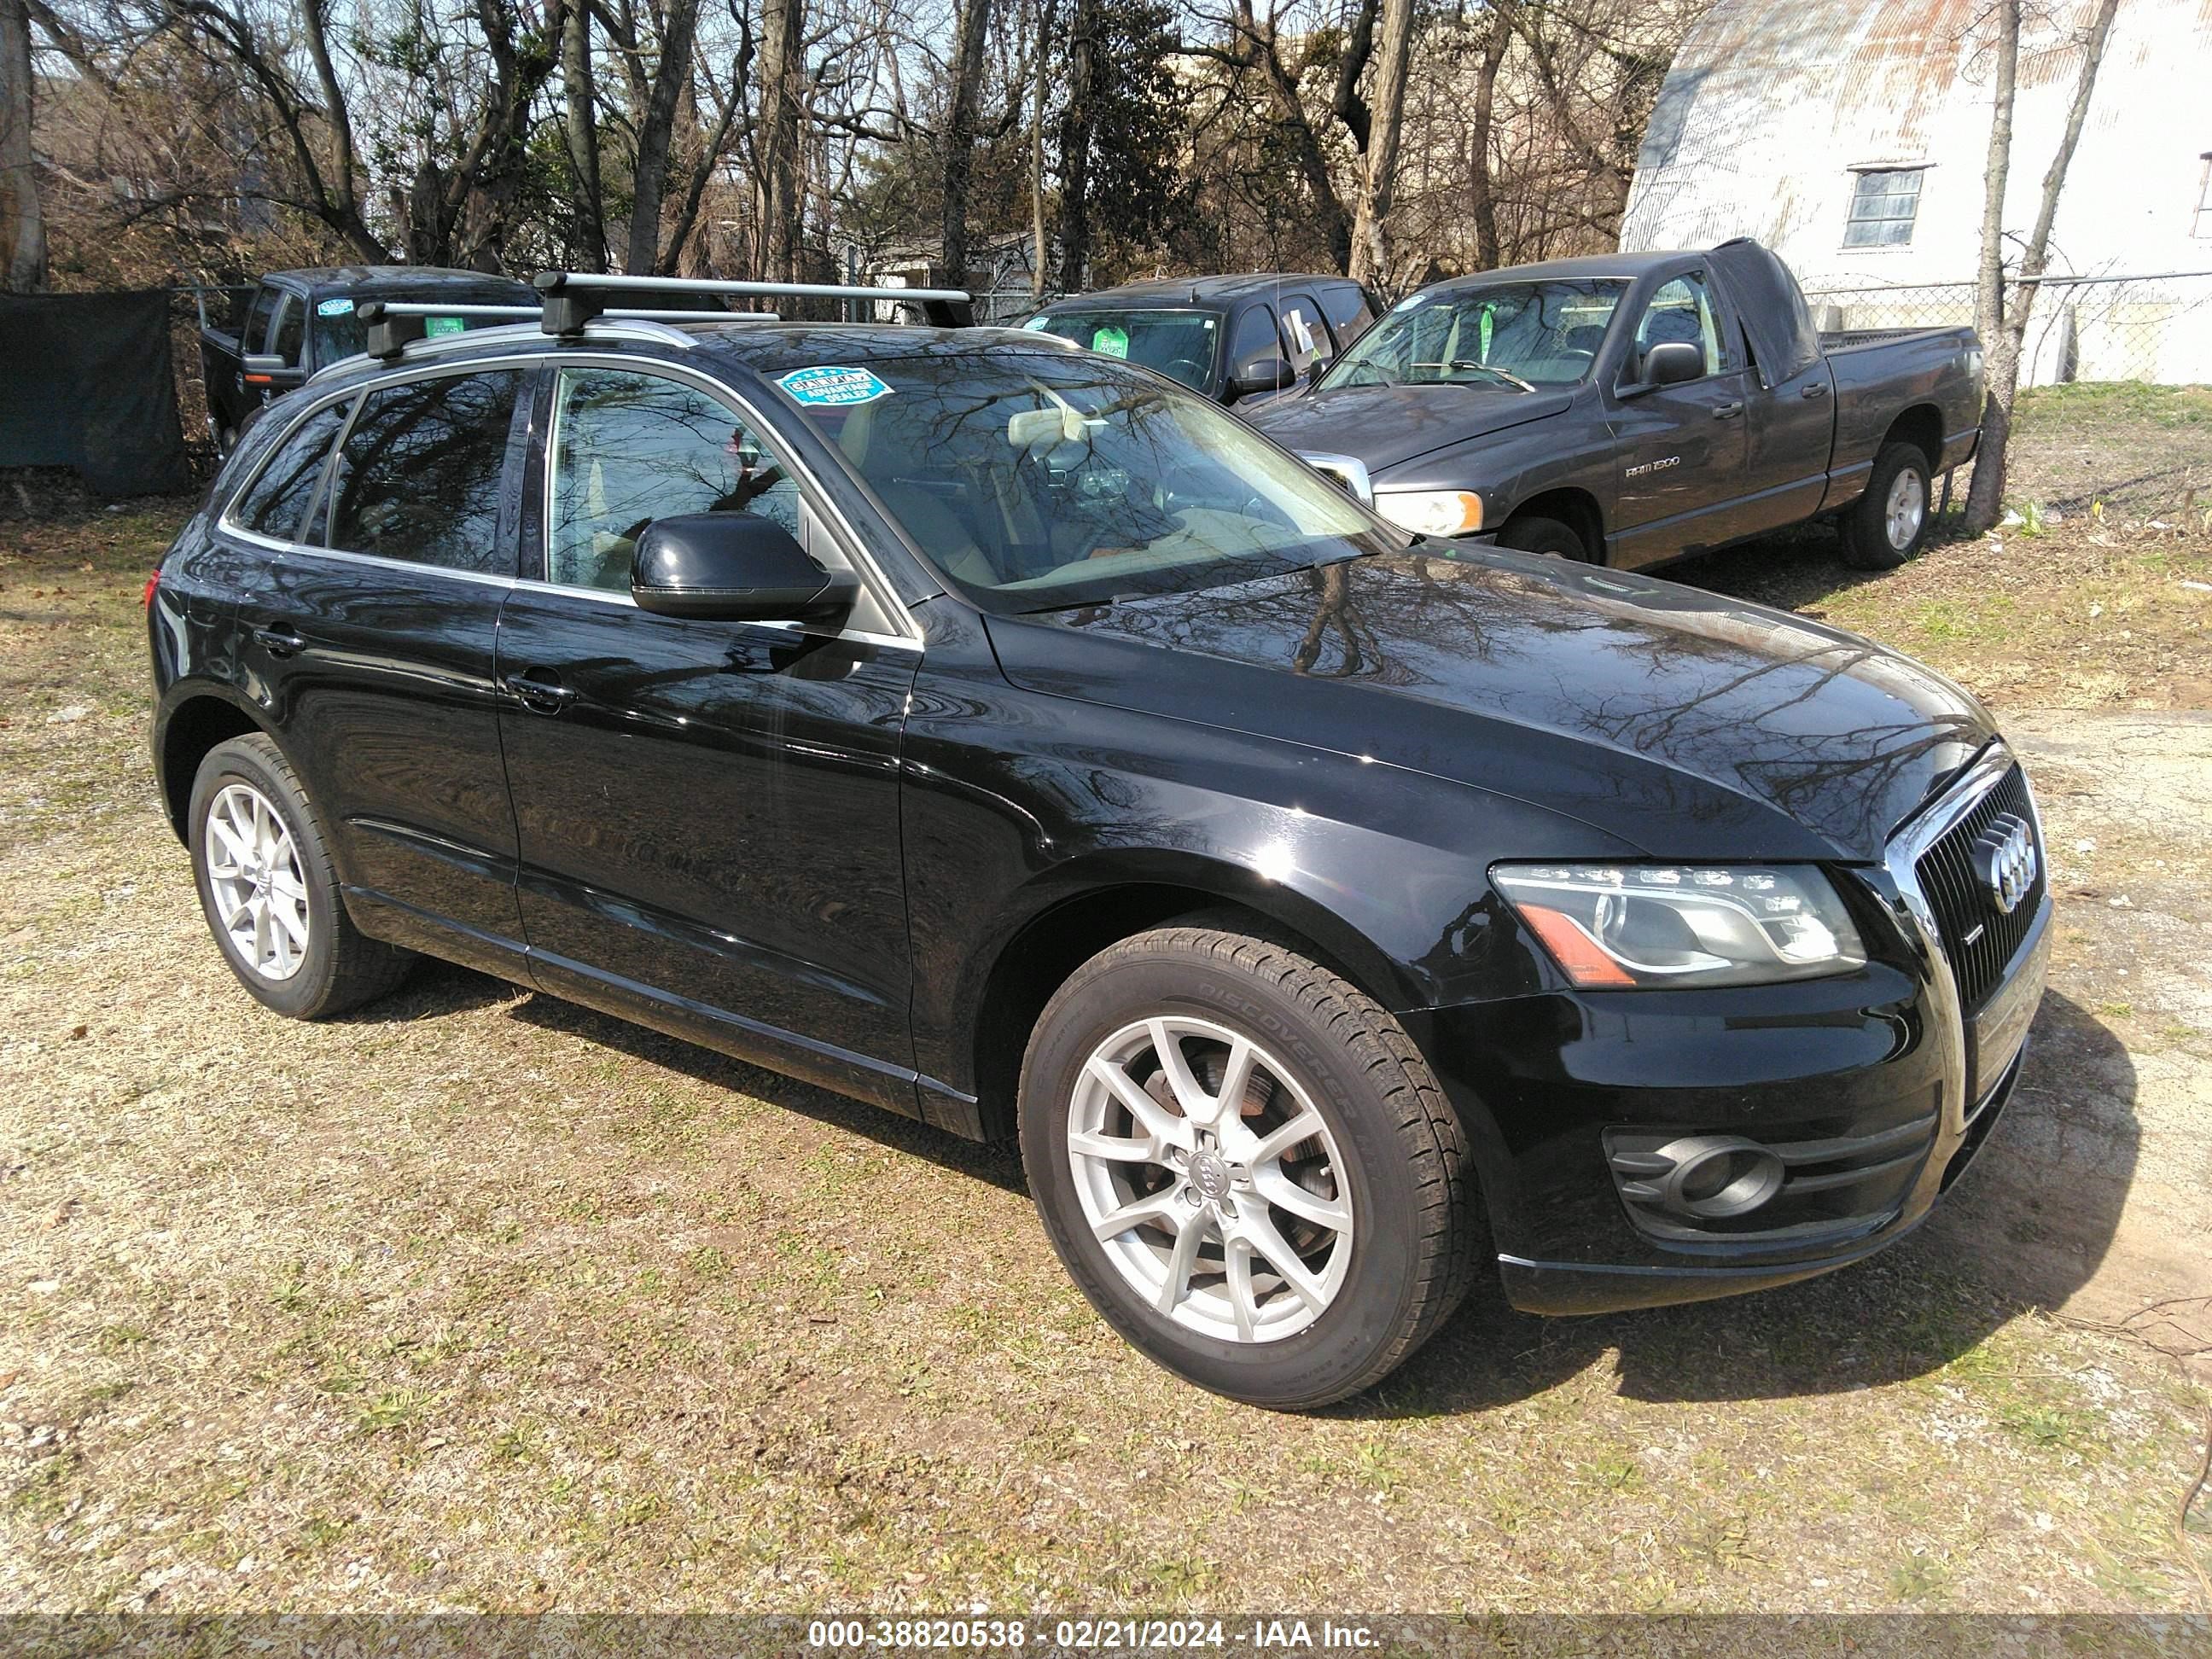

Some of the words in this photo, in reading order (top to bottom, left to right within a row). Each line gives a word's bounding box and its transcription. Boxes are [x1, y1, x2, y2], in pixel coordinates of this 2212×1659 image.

[806, 381, 875, 398] ADVANTAGE
[824, 390, 872, 403] DEALER
[1653, 456, 1680, 470] 1500
[1198, 982, 1359, 1119] DISCOVERER
